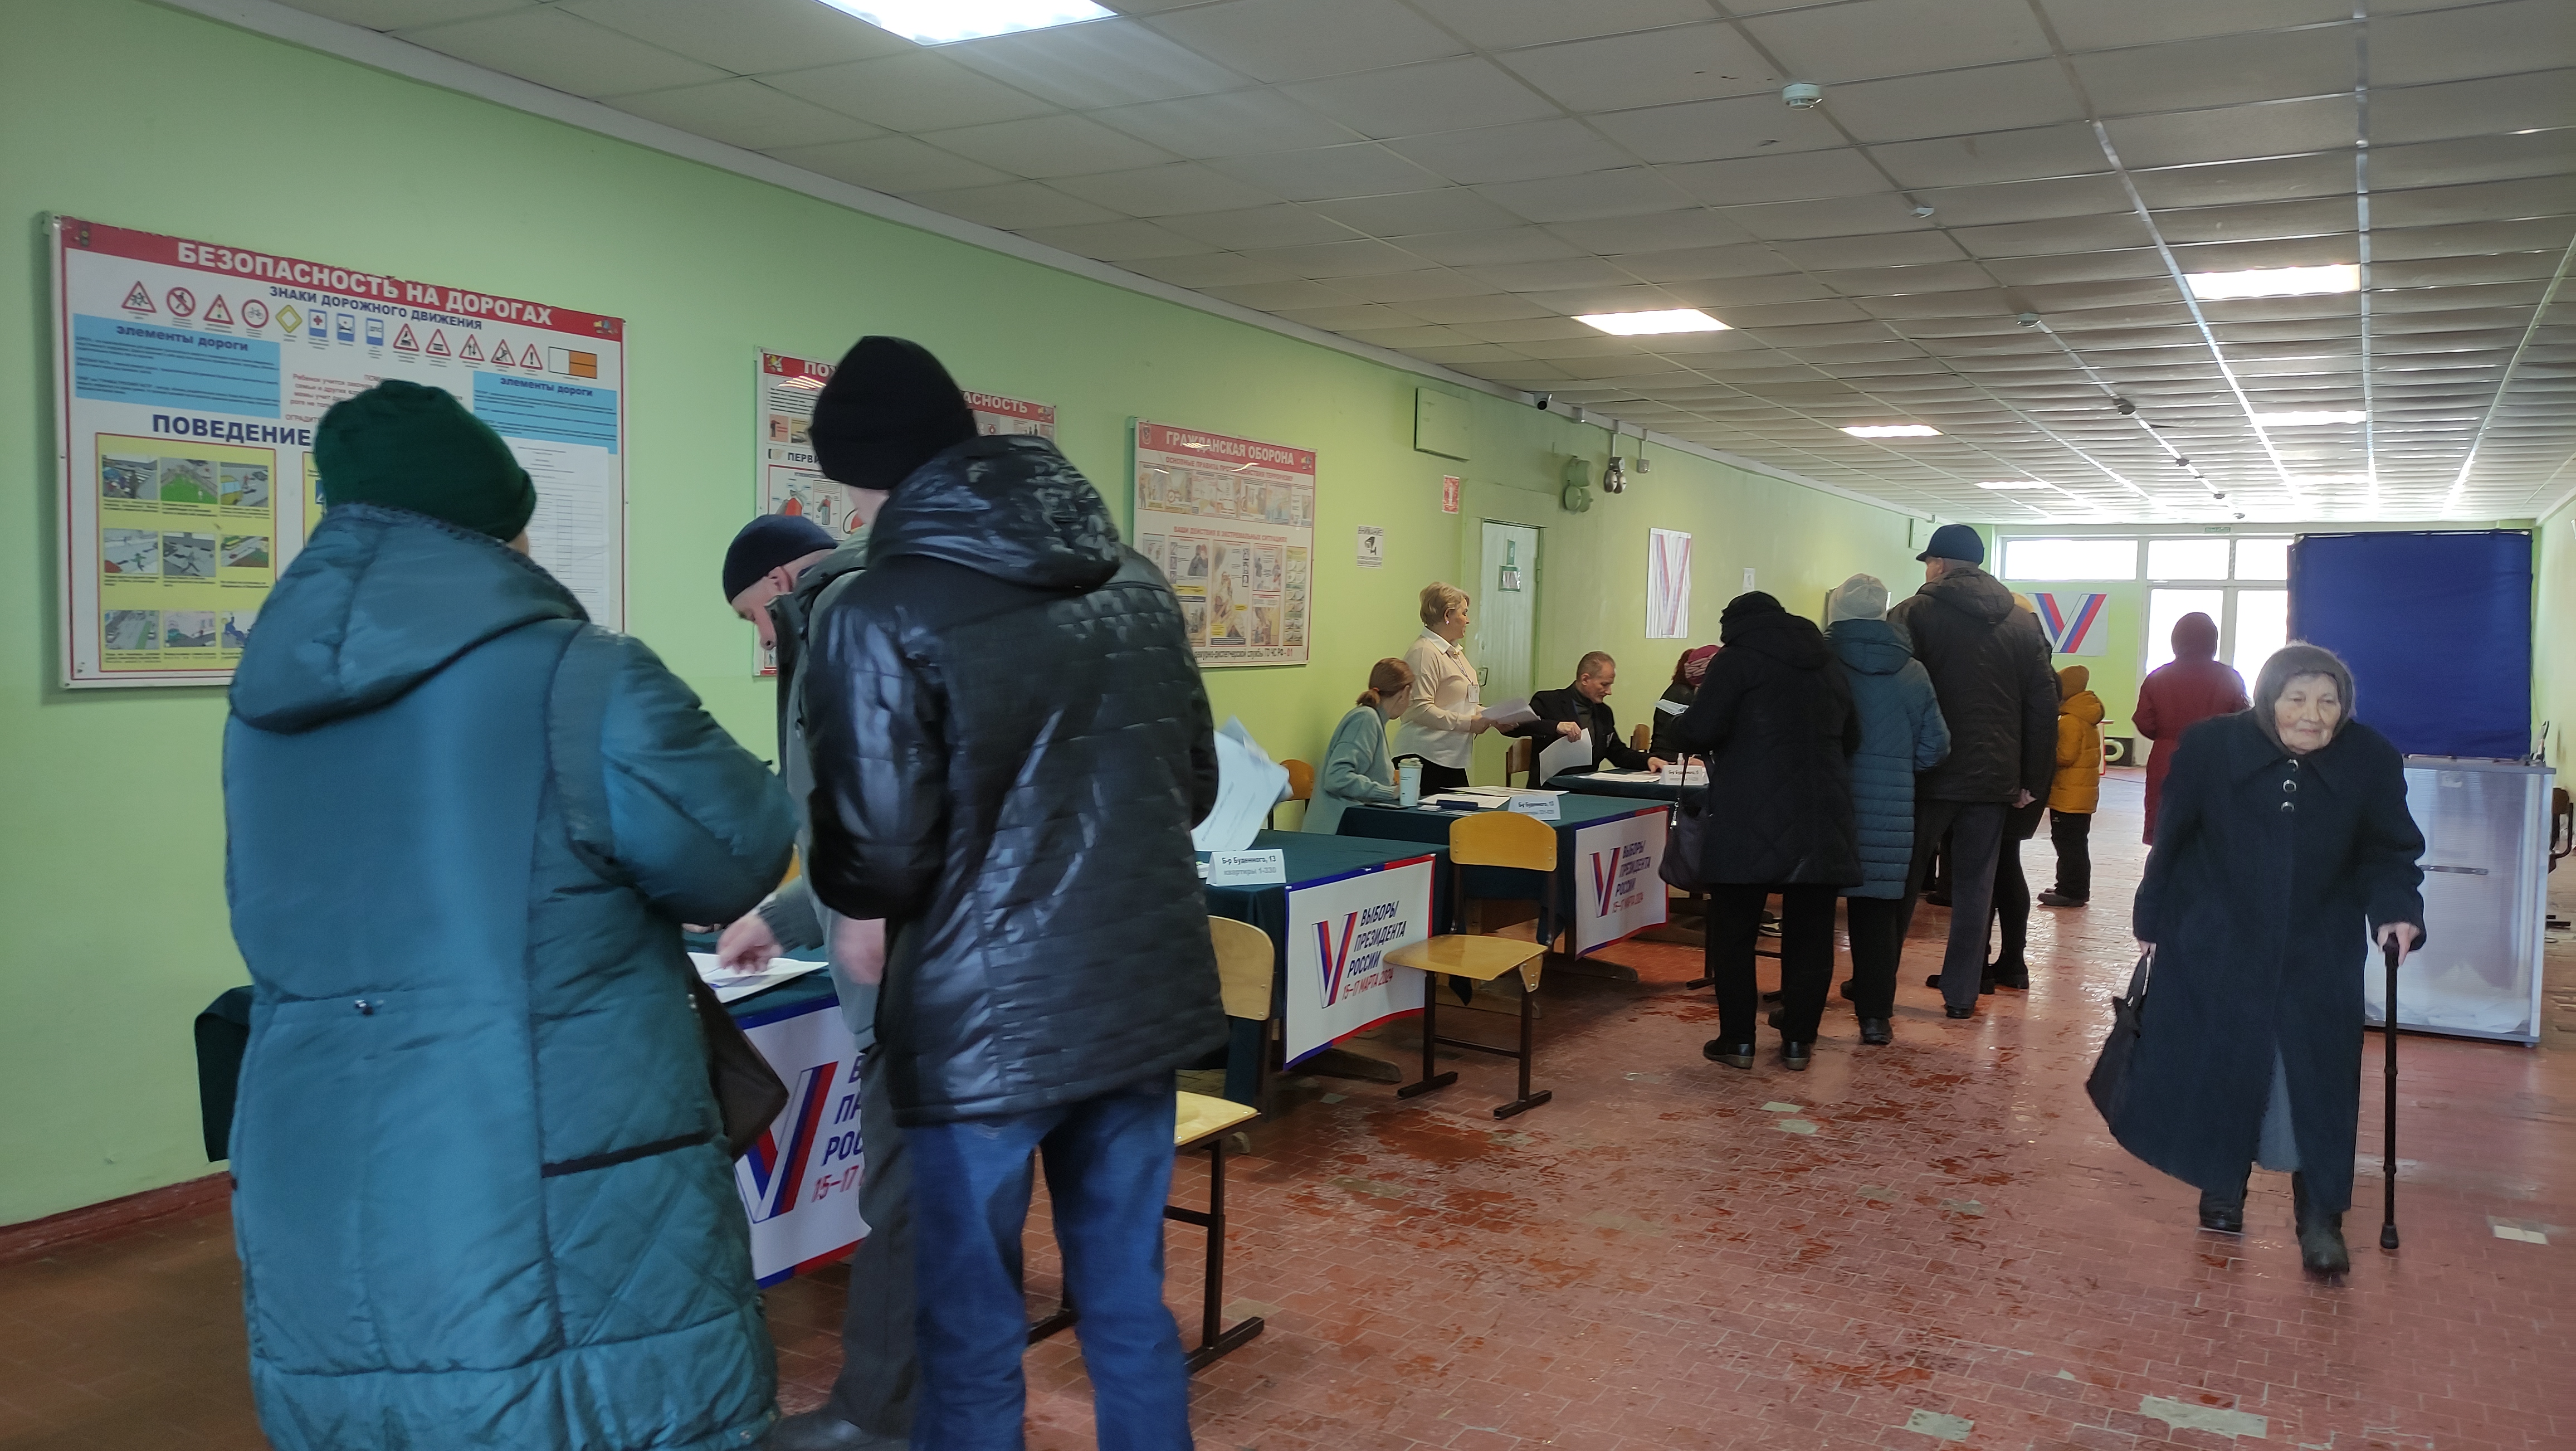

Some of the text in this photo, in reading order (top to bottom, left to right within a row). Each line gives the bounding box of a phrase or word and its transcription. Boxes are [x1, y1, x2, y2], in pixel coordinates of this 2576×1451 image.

[178, 241, 553, 326] БЕЗОПАСНОСТЬ НА ДОРОГАХ
[270, 286, 482, 330] ЗНАКИ ДОРОЖНОГО ДВИЖЕНИЯ
[116, 325, 248, 351] элементы дороги
[500, 378, 593, 397] элементы дороги
[153, 414, 311, 446] ПОВЕДЕНИЕ
[1166, 431, 1295, 465] ГРАЖДАНСКАЯ ОБОРОНА
[1360, 900, 1399, 927] ВЫБОРЫ
[1354, 921, 1407, 953] ПРЕЗИДЕНТА
[1347, 950, 1382, 978] РОССИИ
